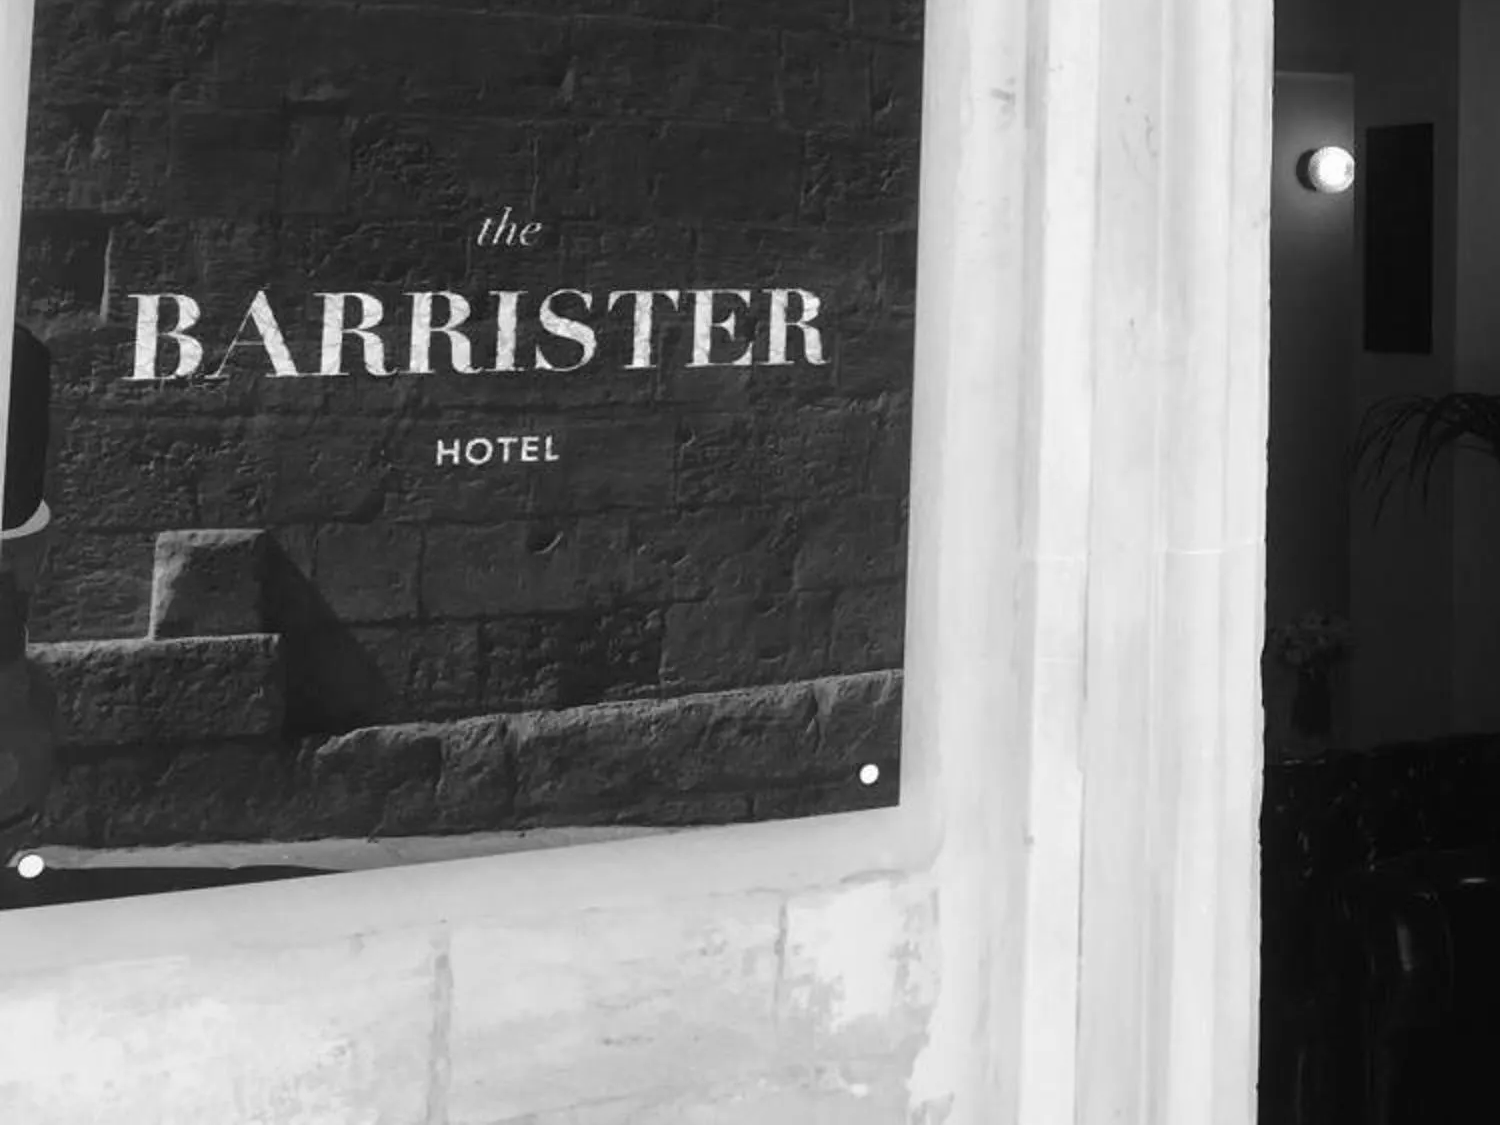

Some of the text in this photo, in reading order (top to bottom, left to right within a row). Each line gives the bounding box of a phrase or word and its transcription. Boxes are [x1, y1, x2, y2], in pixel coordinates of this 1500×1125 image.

[475, 205, 544, 248] the
[122, 282, 832, 382] BARRISTER
[435, 434, 561, 467] HOTEL
